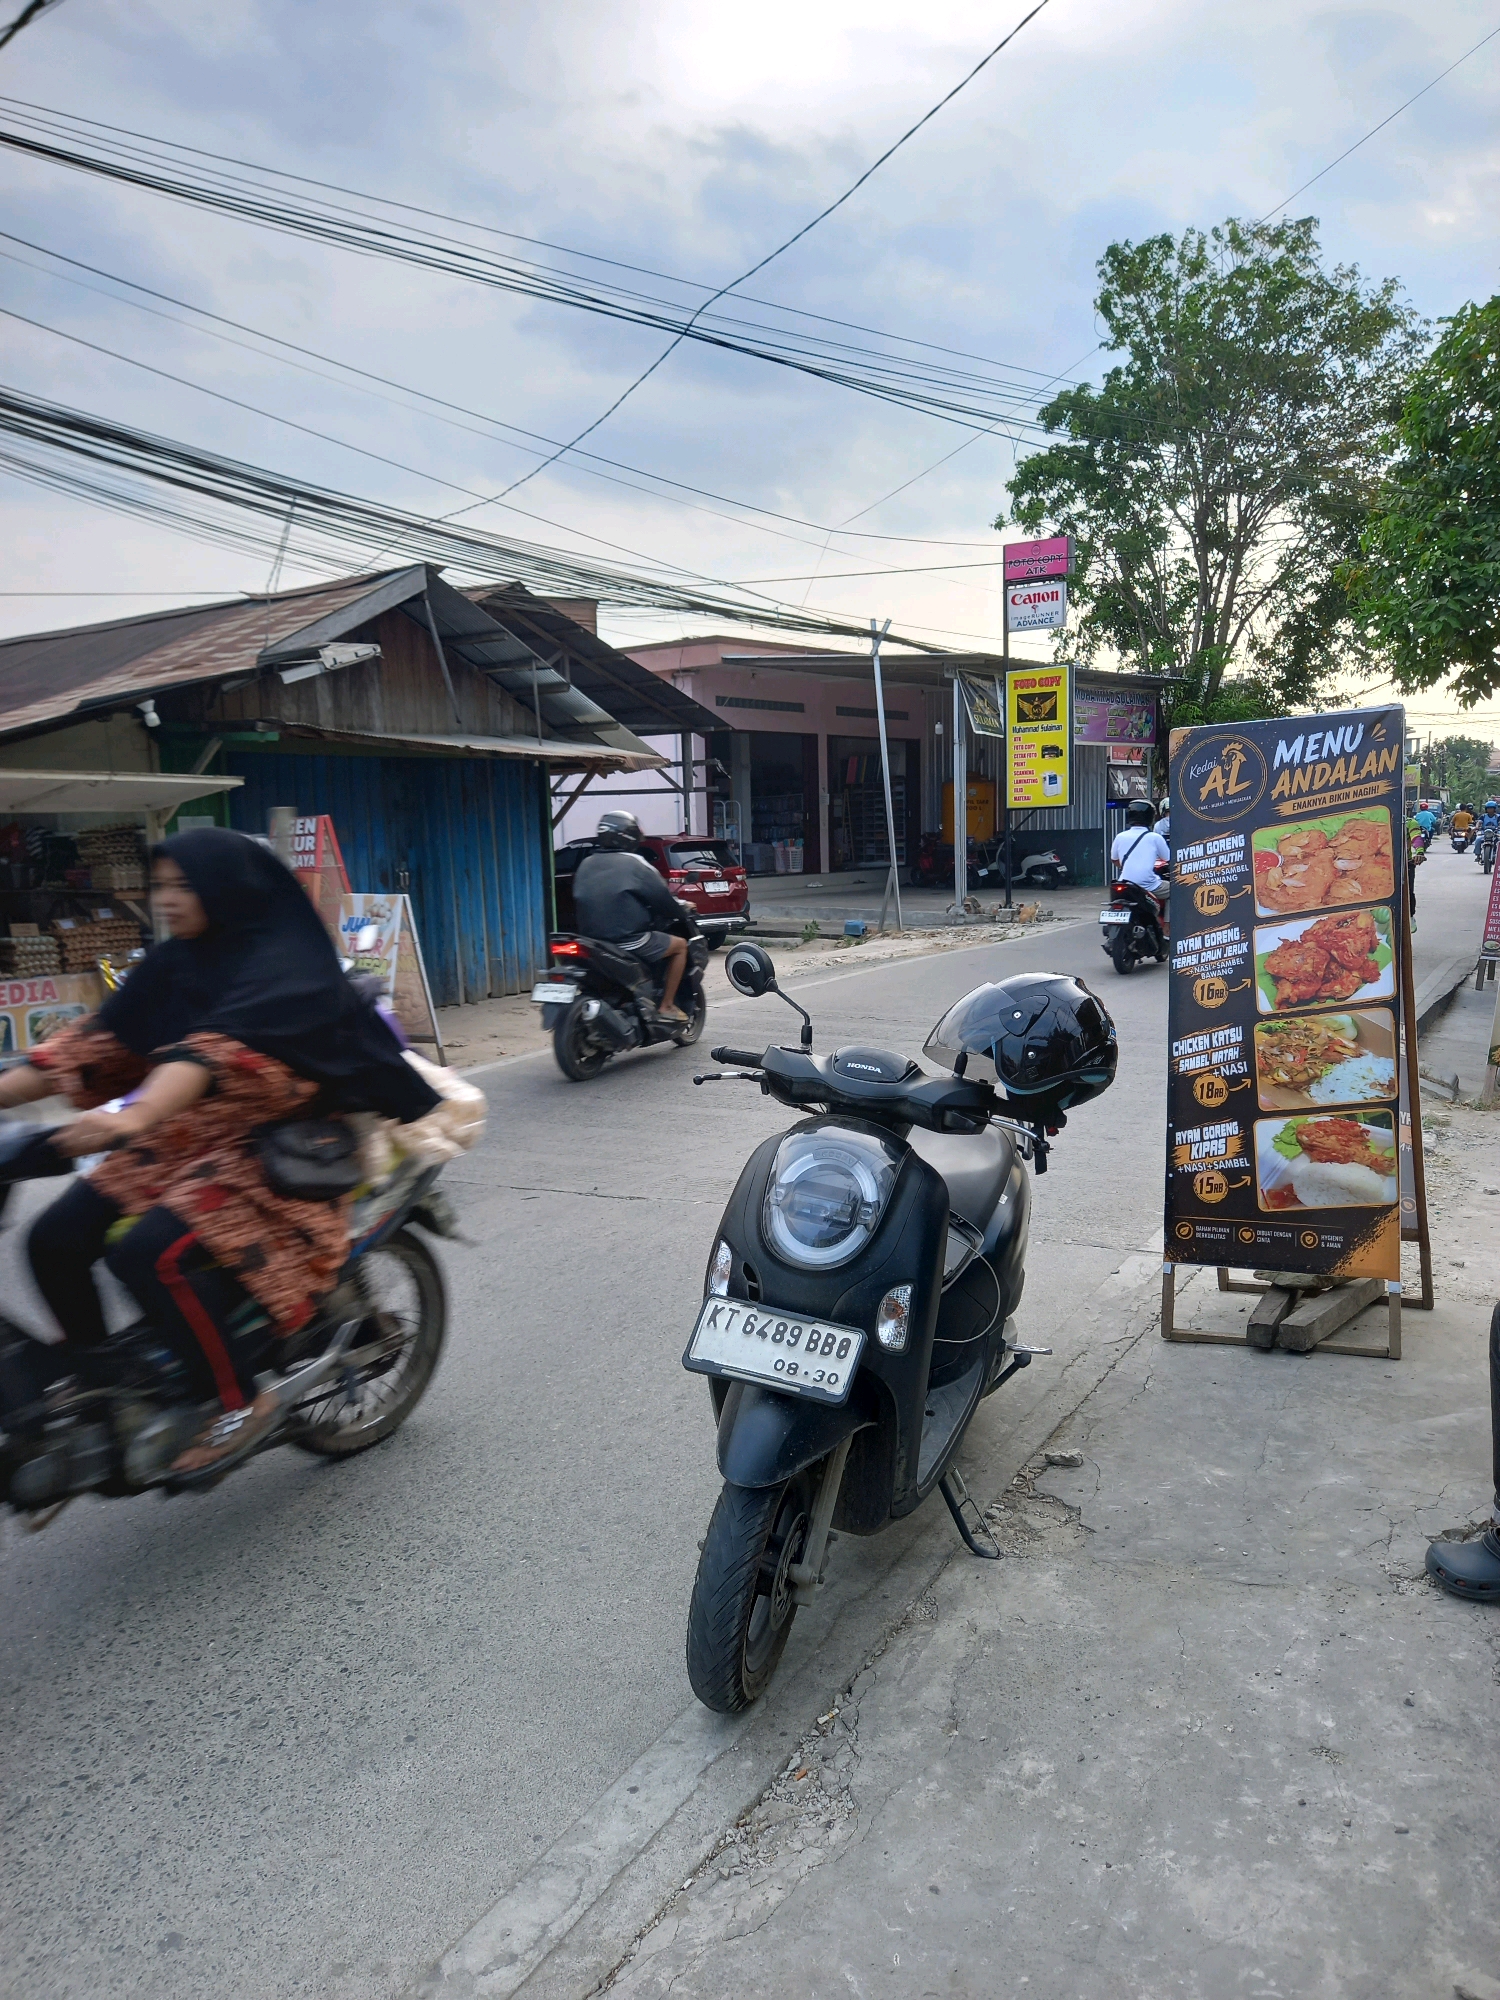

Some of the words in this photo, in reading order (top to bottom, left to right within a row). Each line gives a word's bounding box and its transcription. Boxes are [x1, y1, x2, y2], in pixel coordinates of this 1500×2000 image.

[1008, 557, 1035, 568] FOTO
[1038, 553, 1064, 564] COPY
[1025, 565, 1047, 576] ATK
[1011, 590, 1060, 606] Canon
[1016, 616, 1055, 628] ADVANCE
[1013, 678, 1037, 690] FOTO
[1038, 676, 1062, 688] COPY
[1012, 725, 1040, 733] Muhammad
[1041, 724, 1063, 732] Sulaiman
[1273, 722, 1364, 771] MENU
[1189, 756, 1218, 779] Kedai
[1270, 743, 1399, 801] ANDALAN
[1199, 759, 1253, 802] AL
[1292, 796, 1328, 812] ENAKNYA
[1329, 790, 1351, 804] BIKIN
[1352, 784, 1380, 797] NAGIH!
[1176, 843, 1204, 862] AYAM
[1206, 834, 1246, 855] GORENG
[1181, 857, 1217, 875] BAWANG
[1218, 850, 1244, 866] PUTIH
[1205, 874, 1239, 886] BAWANG
[1176, 938, 1203, 955] AYAM
[1204, 927, 1241, 948] GORENG
[1172, 953, 1200, 970] TERASI
[1200, 947, 1223, 964] DAUN
[1223, 941, 1249, 958] JERUK
[1201, 967, 1234, 980] BAWANG
[1173, 1034, 1210, 1057] CHICKEN
[1211, 1026, 1243, 1048] KATSU
[846, 1061, 883, 1075] HONDA
[1178, 1053, 1210, 1073] SAMBEL
[1211, 1046, 1240, 1065] MATAH
[1175, 1128, 1201, 1146] AYAM
[1202, 1121, 1239, 1140] GORENG
[1190, 1138, 1226, 1160] KIPAS
[1256, 1229, 1273, 1237] DIBUAT
[1273, 1231, 1292, 1239] DENGAN
[1326, 1241, 1342, 1249] AMAN
[707, 1304, 740, 1331] KT
[742, 1313, 803, 1347] 6489
